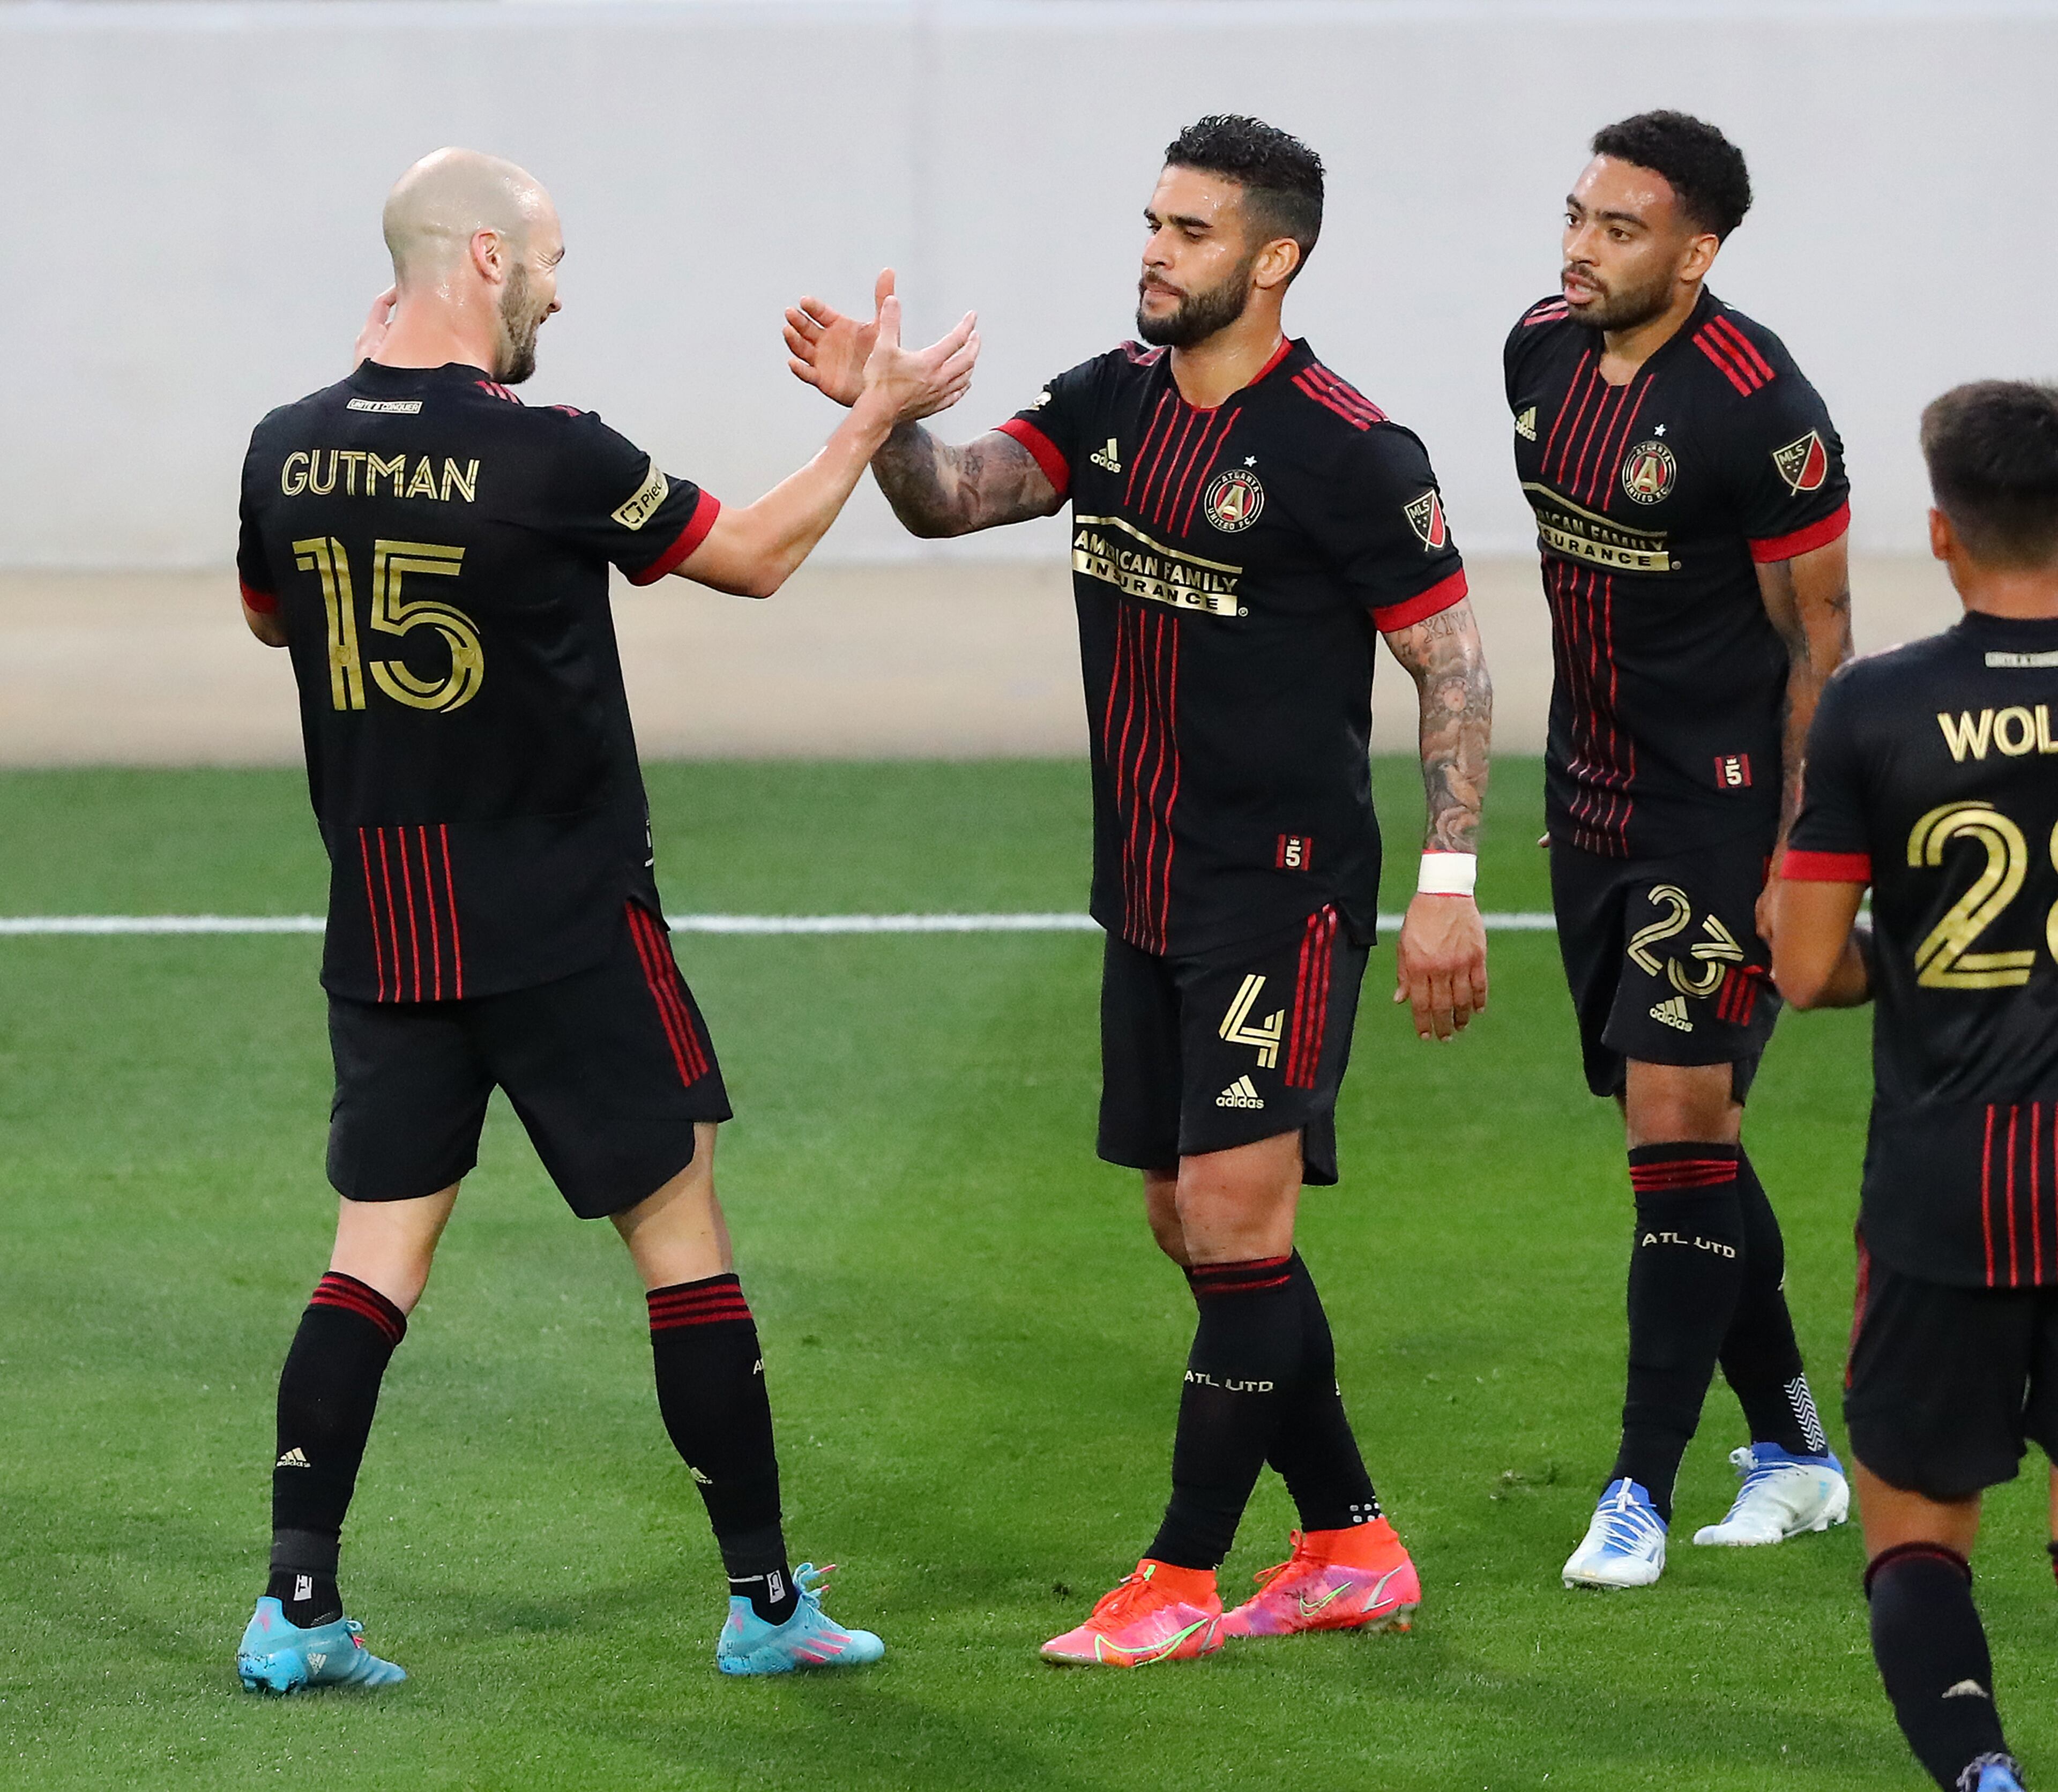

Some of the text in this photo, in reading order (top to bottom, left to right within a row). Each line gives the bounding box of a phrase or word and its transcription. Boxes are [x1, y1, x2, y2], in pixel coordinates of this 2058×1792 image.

[381, 403, 419, 412] CONQUER
[1090, 453, 1121, 473] adas
[1778, 444, 1805, 465] MLS
[281, 449, 480, 502] GUTMAN
[1221, 472, 1259, 492] ATLANTA
[1208, 508, 1250, 529] UNITED FC
[1409, 500, 1430, 519] MLS
[1073, 529, 1237, 593] AMICAN FAMILY
[1086, 557, 1218, 610] INSURANCE
[292, 537, 484, 713] 15
[1937, 704, 2058, 763] WOL
[1725, 764, 1742, 785] 5
[1286, 846, 1301, 867] 5
[1907, 801, 2058, 989] 2
[1627, 884, 1744, 999] 23
[1219, 974, 1285, 1069] 4
[1649, 1007, 1693, 1032] adidas
[1216, 1093, 1264, 1109] adidas
[1642, 1232, 1735, 1258] ATL UTD
[1184, 1370, 1273, 1392] ATL UTD
